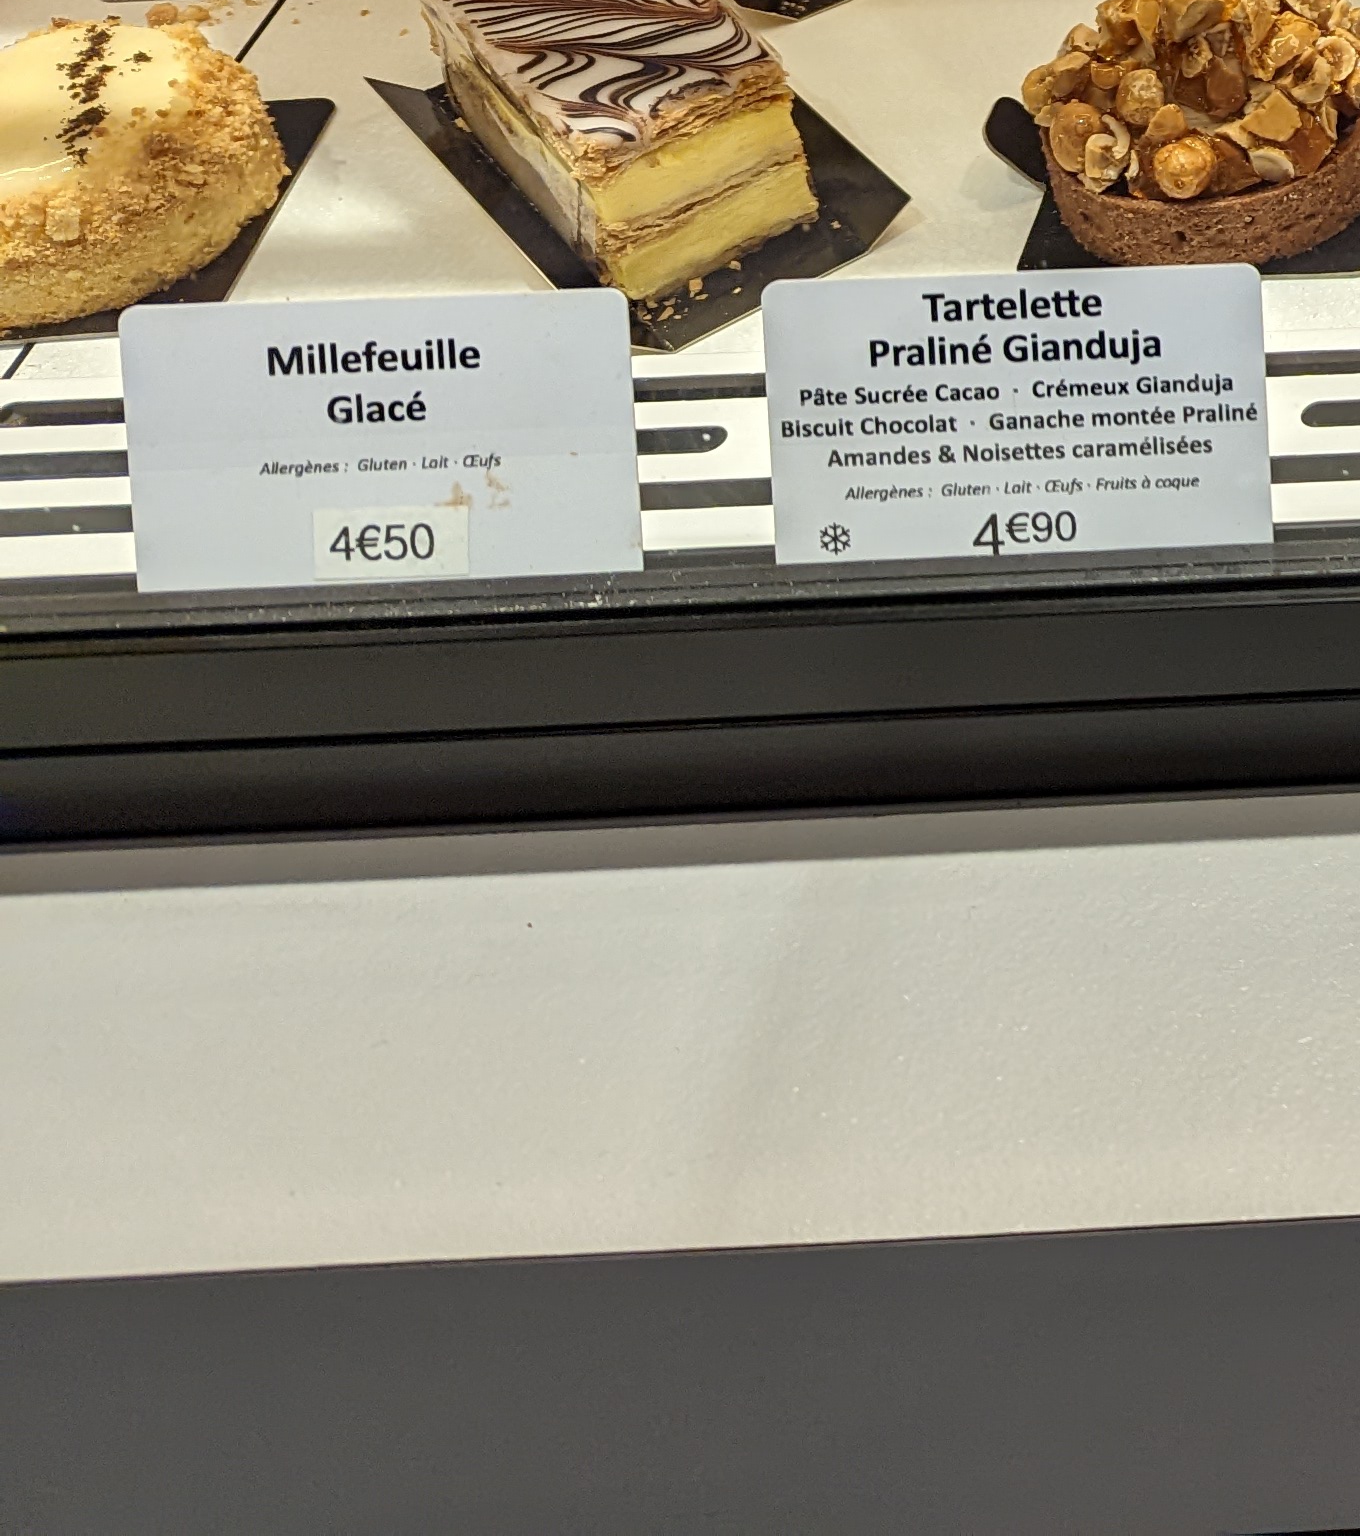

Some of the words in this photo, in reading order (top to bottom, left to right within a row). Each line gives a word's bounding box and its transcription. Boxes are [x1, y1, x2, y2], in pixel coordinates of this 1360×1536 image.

[922, 289, 1102, 322] Tartelette
[268, 339, 480, 376] Millefeuille
[870, 334, 991, 367] Praliné
[1003, 330, 1161, 365] Gianduja
[800, 388, 847, 406] Pâte
[855, 385, 927, 404] Sucrée
[935, 384, 999, 401] Cacao
[1033, 379, 1129, 398] Crémeux
[1136, 374, 1233, 395] Gianduja
[327, 391, 426, 424] Glacé
[782, 419, 853, 437] Biscuit
[861, 415, 957, 435] Chocolat
[989, 410, 1084, 430] Ganache
[1092, 407, 1175, 426] montée
[1183, 403, 1257, 423] Praliné
[260, 460, 339, 477] Allergènes
[358, 458, 407, 471] Gluten
[422, 456, 448, 469] Lait
[828, 446, 931, 467] Amandes
[939, 445, 956, 463] &
[963, 444, 1065, 462] Noisettes
[1073, 436, 1212, 458] caramélisées
[845, 485, 923, 502] Allergènes
[941, 483, 990, 496] Gluten
[1004, 481, 1032, 494] Lait
[1096, 477, 1136, 490] Fruits
[1141, 476, 1151, 489] à
[1155, 477, 1199, 490] coque
[330, 523, 434, 561] 4€50
[972, 510, 1078, 556] 4€90
